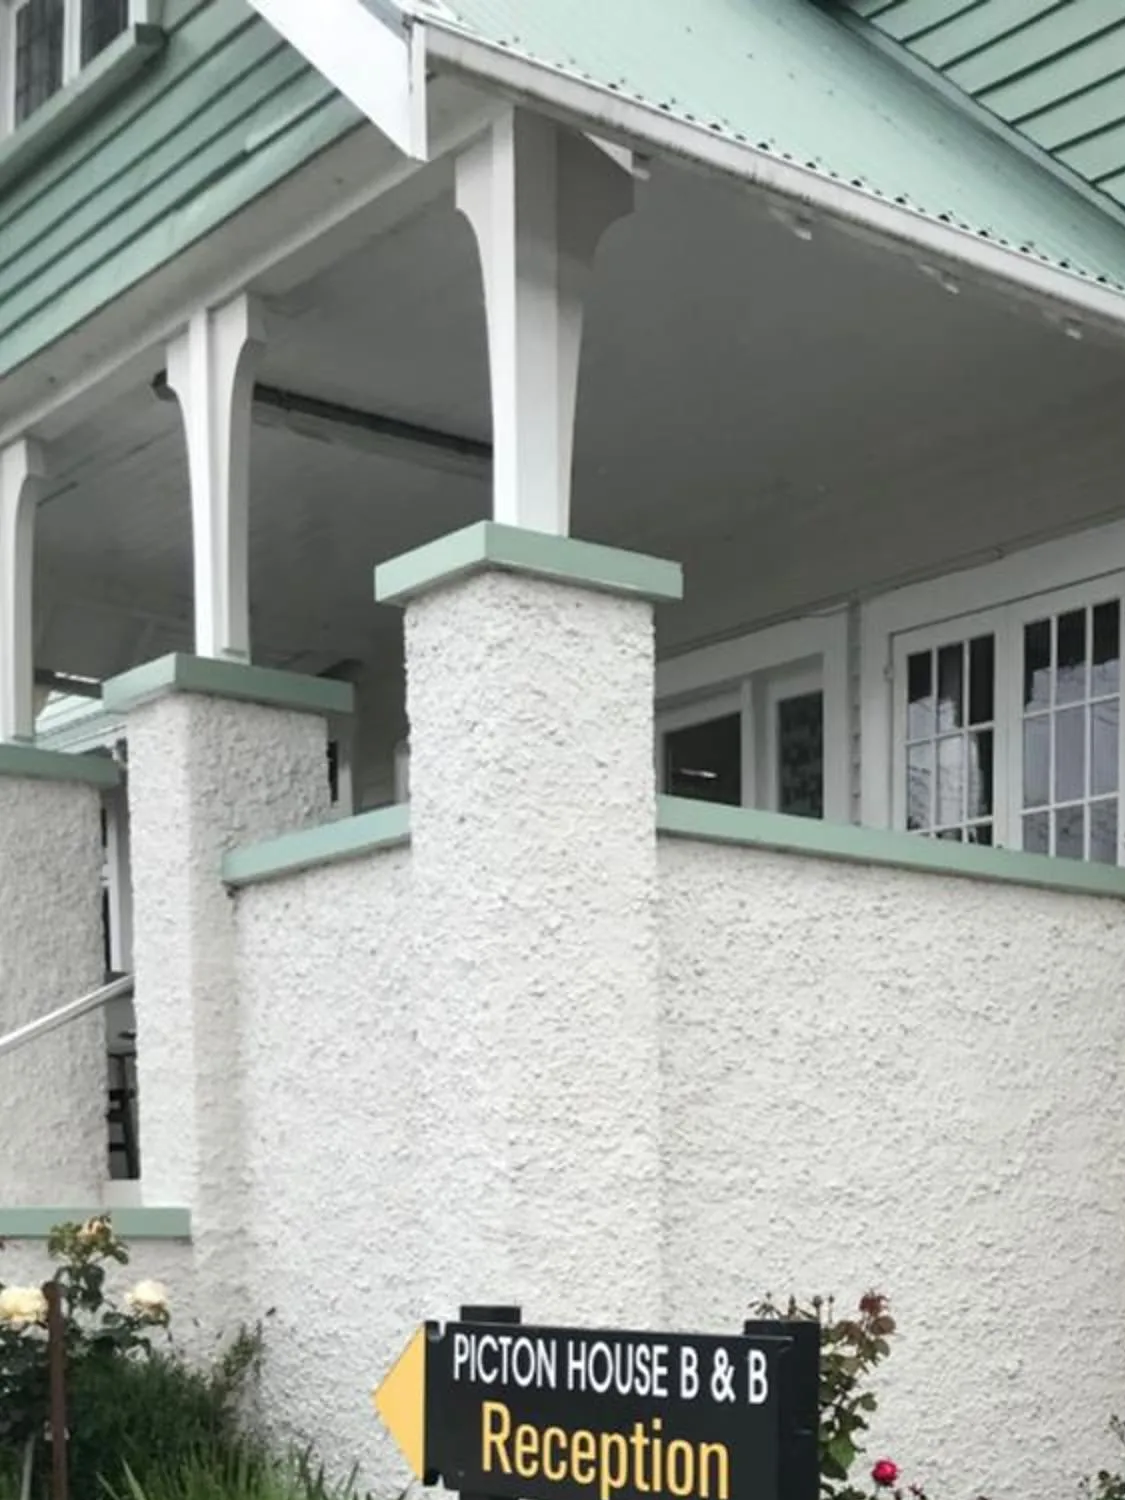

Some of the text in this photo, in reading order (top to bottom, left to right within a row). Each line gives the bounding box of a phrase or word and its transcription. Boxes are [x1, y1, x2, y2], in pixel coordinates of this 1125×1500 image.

[452, 1333, 769, 1404] PICTON HOUSE B & B
